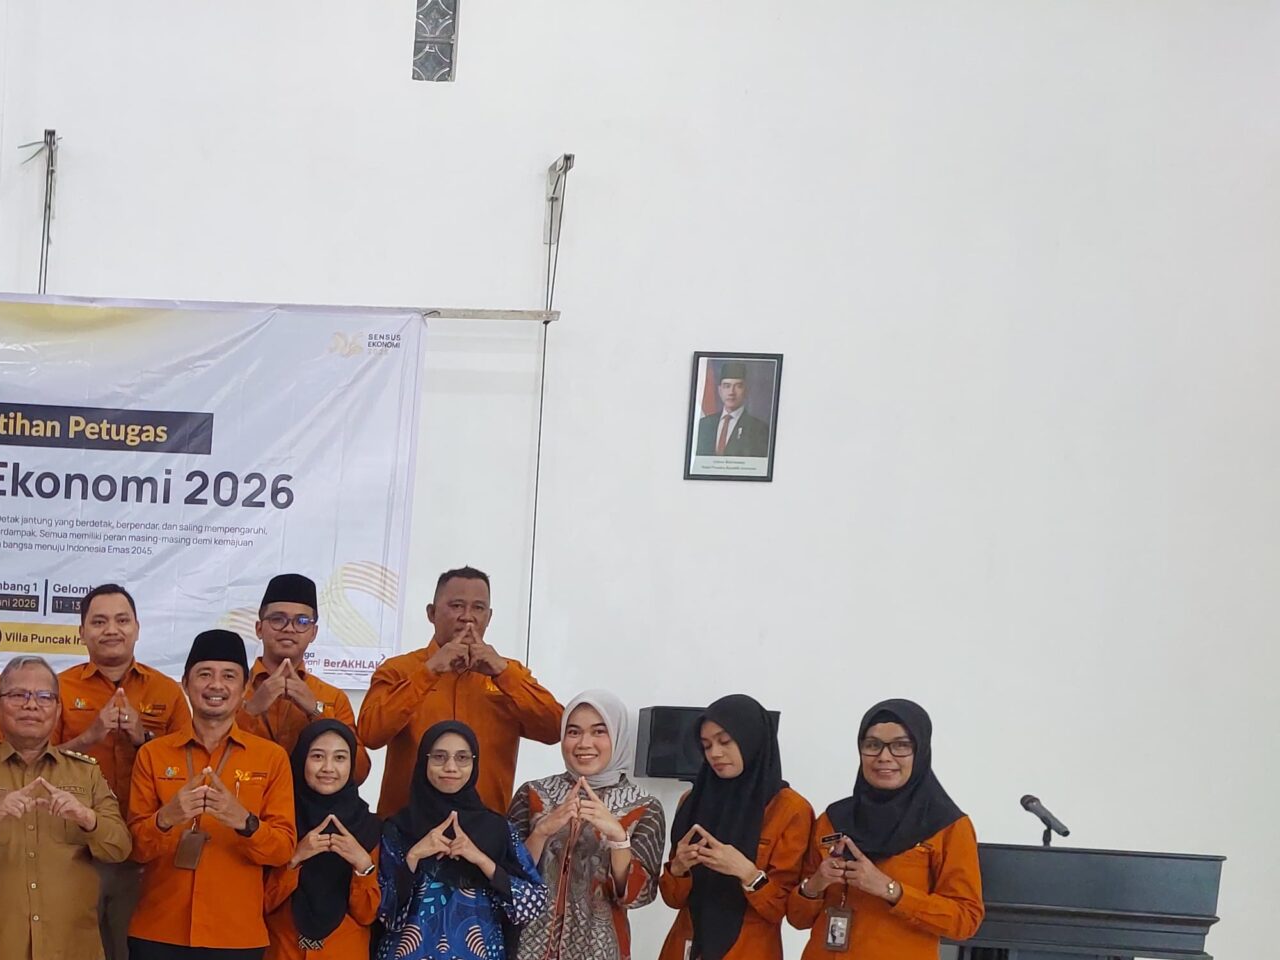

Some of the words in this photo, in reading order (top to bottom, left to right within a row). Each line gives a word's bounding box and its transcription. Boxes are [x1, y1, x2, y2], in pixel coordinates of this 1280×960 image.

[368, 333, 401, 341] SENSUS
[68, 416, 169, 446] Petugas
[183, 470, 295, 510] 2026
[20, 515, 53, 527] jantung
[54, 519, 74, 528] yang
[161, 522, 178, 531] dan
[178, 523, 204, 534] saling
[39, 529, 68, 540] Semua
[68, 531, 102, 541] memiliki
[103, 533, 127, 543] peran
[128, 534, 191, 547] masing-masing
[192, 536, 213, 546] demi
[213, 537, 254, 548] kemajuan
[2, 540, 33, 552] bangsa
[34, 543, 65, 553] menuju
[66, 544, 106, 554] Indonesia
[107, 545, 130, 555] Emas
[33, 583, 38, 592] 1
[11, 598, 37, 609] 2026
[55, 600, 63, 609] 11
[5, 632, 28, 643] Villa
[30, 633, 71, 645] Puncak
